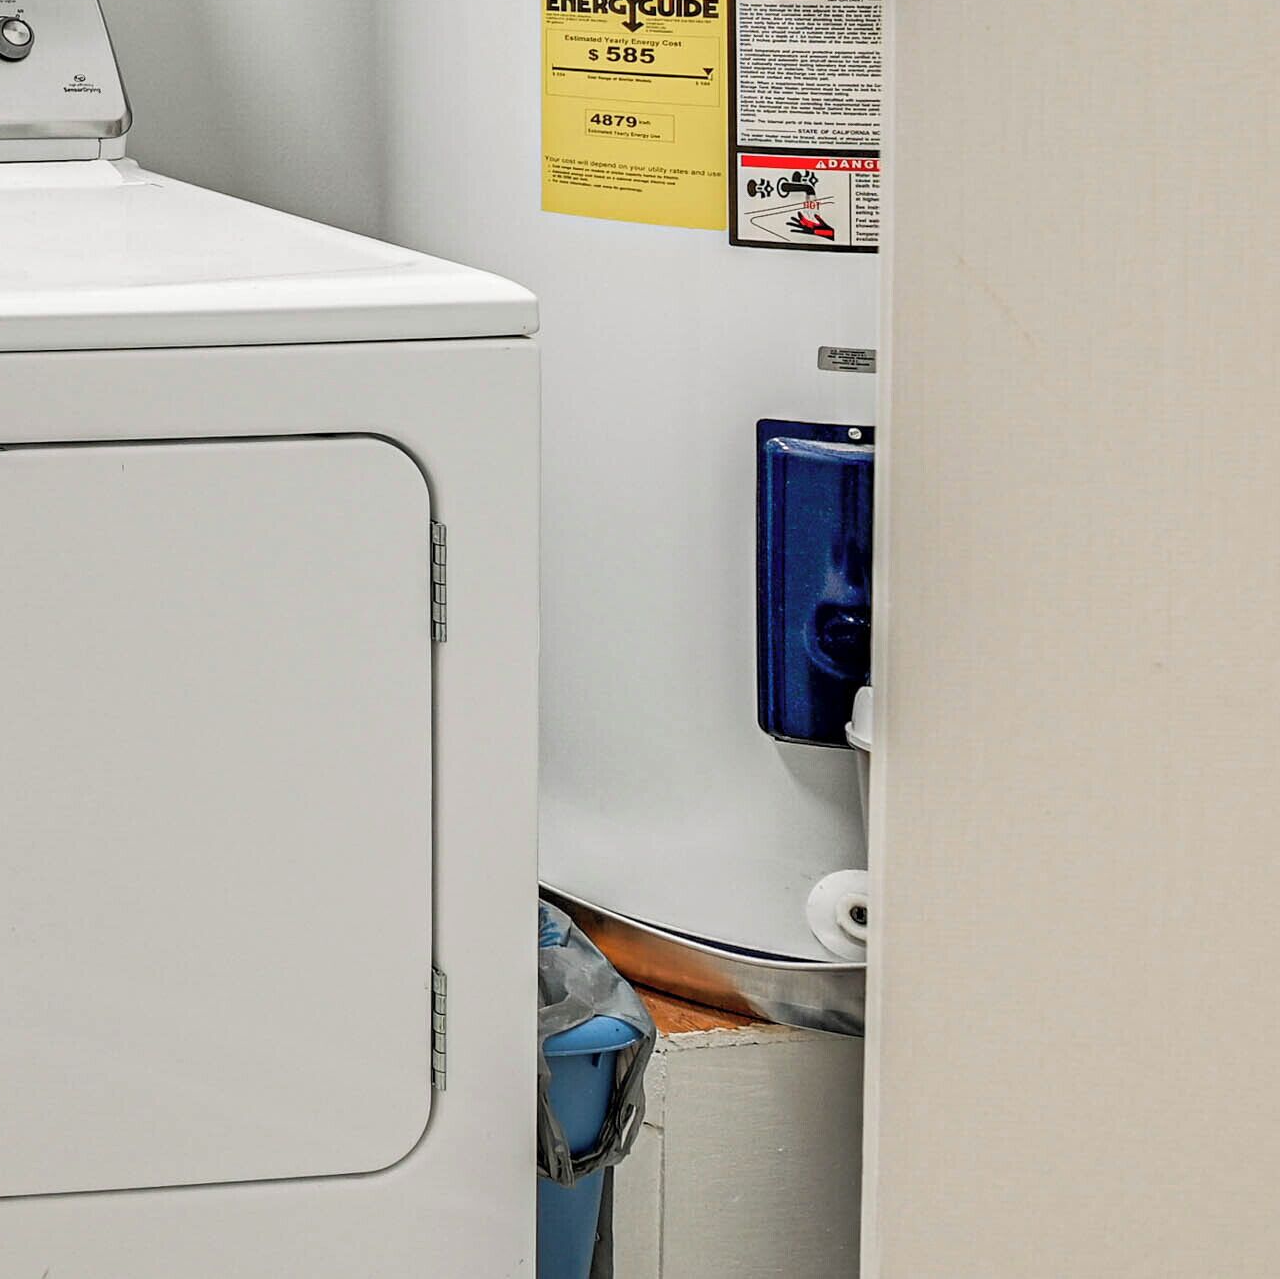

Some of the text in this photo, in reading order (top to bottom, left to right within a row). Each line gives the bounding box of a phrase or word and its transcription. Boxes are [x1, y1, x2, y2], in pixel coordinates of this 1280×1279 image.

[564, 34, 602, 43] Estimated
[604, 37, 629, 45] Yearly
[631, 38, 661, 48] Energy
[588, 47, 655, 64] $ 585
[590, 114, 638, 127] 4879
[590, 160, 616, 169] depend
[648, 166, 667, 174] utility
